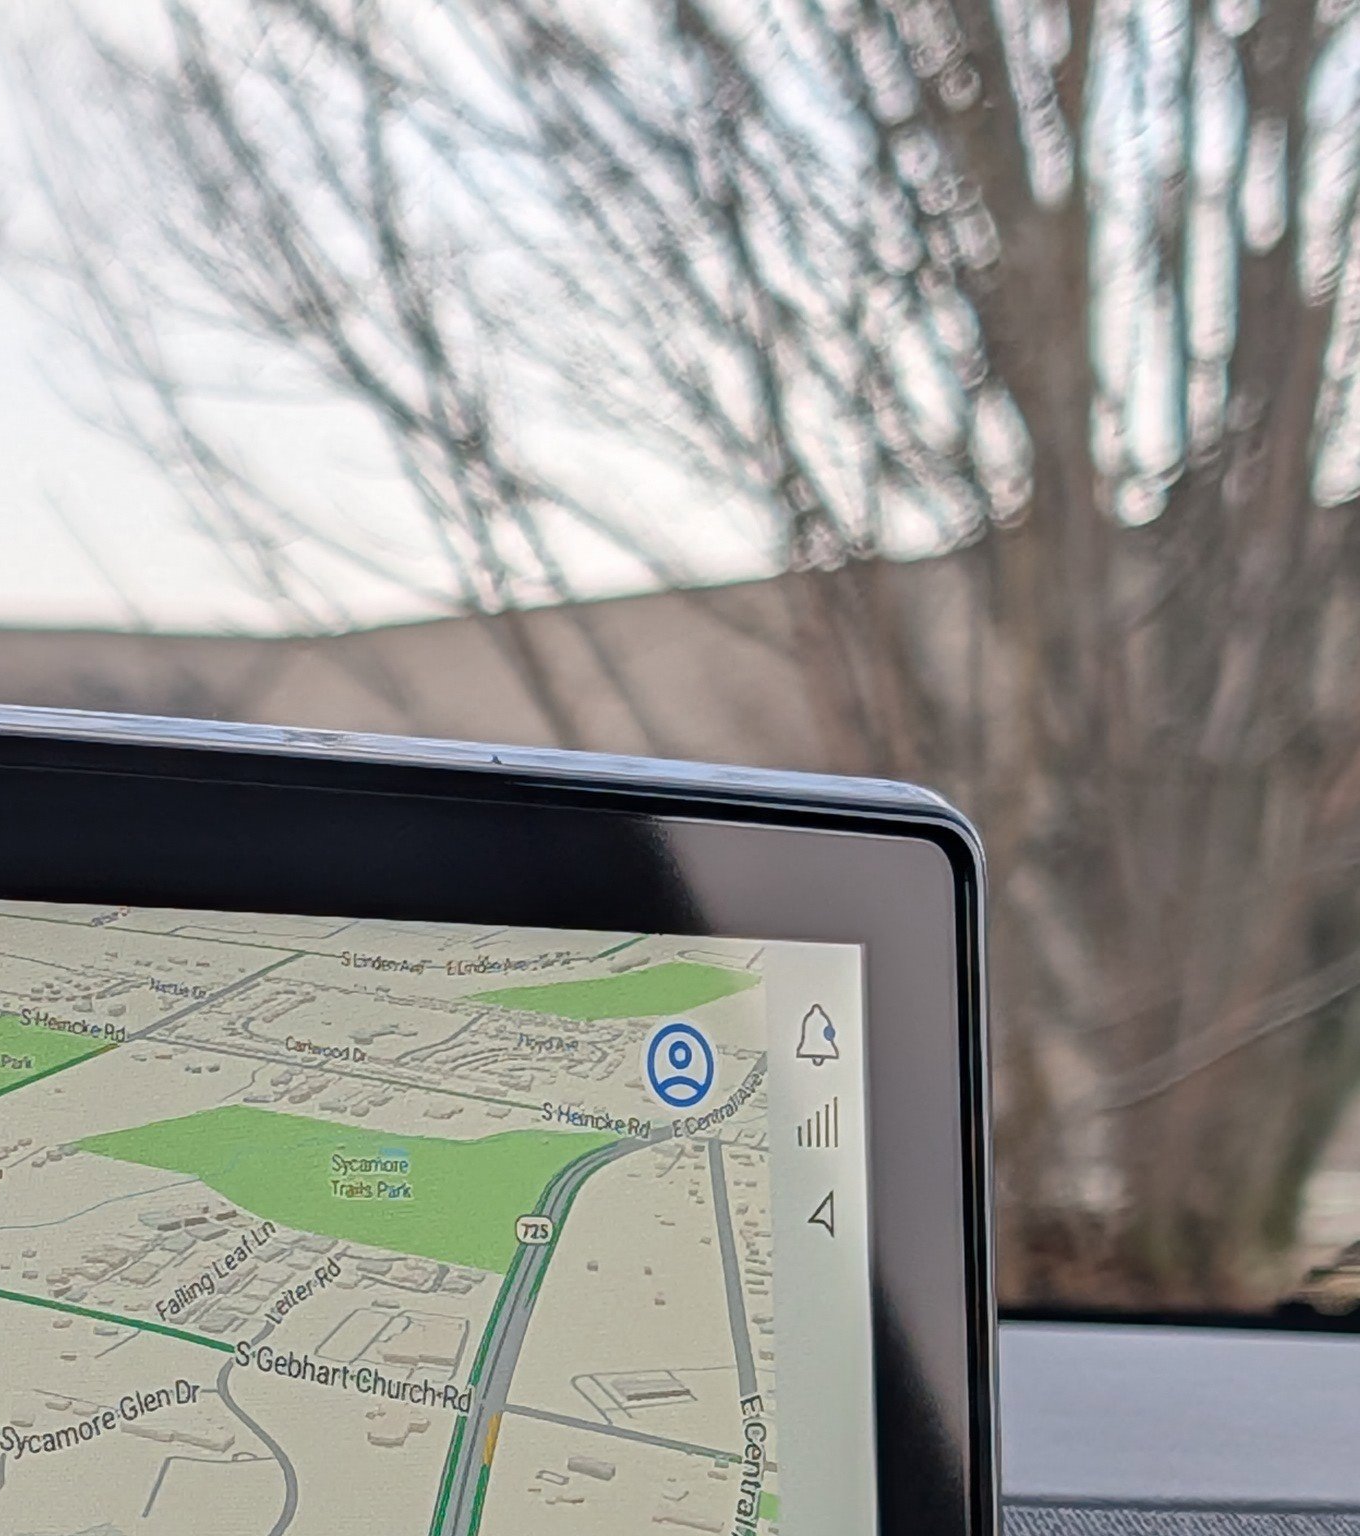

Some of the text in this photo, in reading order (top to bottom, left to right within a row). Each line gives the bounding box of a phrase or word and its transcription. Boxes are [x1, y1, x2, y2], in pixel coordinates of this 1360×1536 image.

[341, 951, 351, 966] S
[20, 1008, 126, 1042] S Heincke Rd
[542, 1102, 650, 1139] S Heincke Rd
[673, 1073, 762, 1138] E Central Ave
[332, 1154, 408, 1177] Sycamore
[331, 1180, 411, 1198] Trails Park
[521, 1222, 549, 1239] 725
[156, 1220, 276, 1321] Falling Leaf Ln
[265, 1258, 342, 1325] Leiter Rd
[235, 1341, 472, 1414] S Gebhart Church Rd
[0, 1380, 201, 1460] Sycamore Glen Dr
[740, 1395, 763, 1416] E
[736, 1422, 767, 1528] Central
